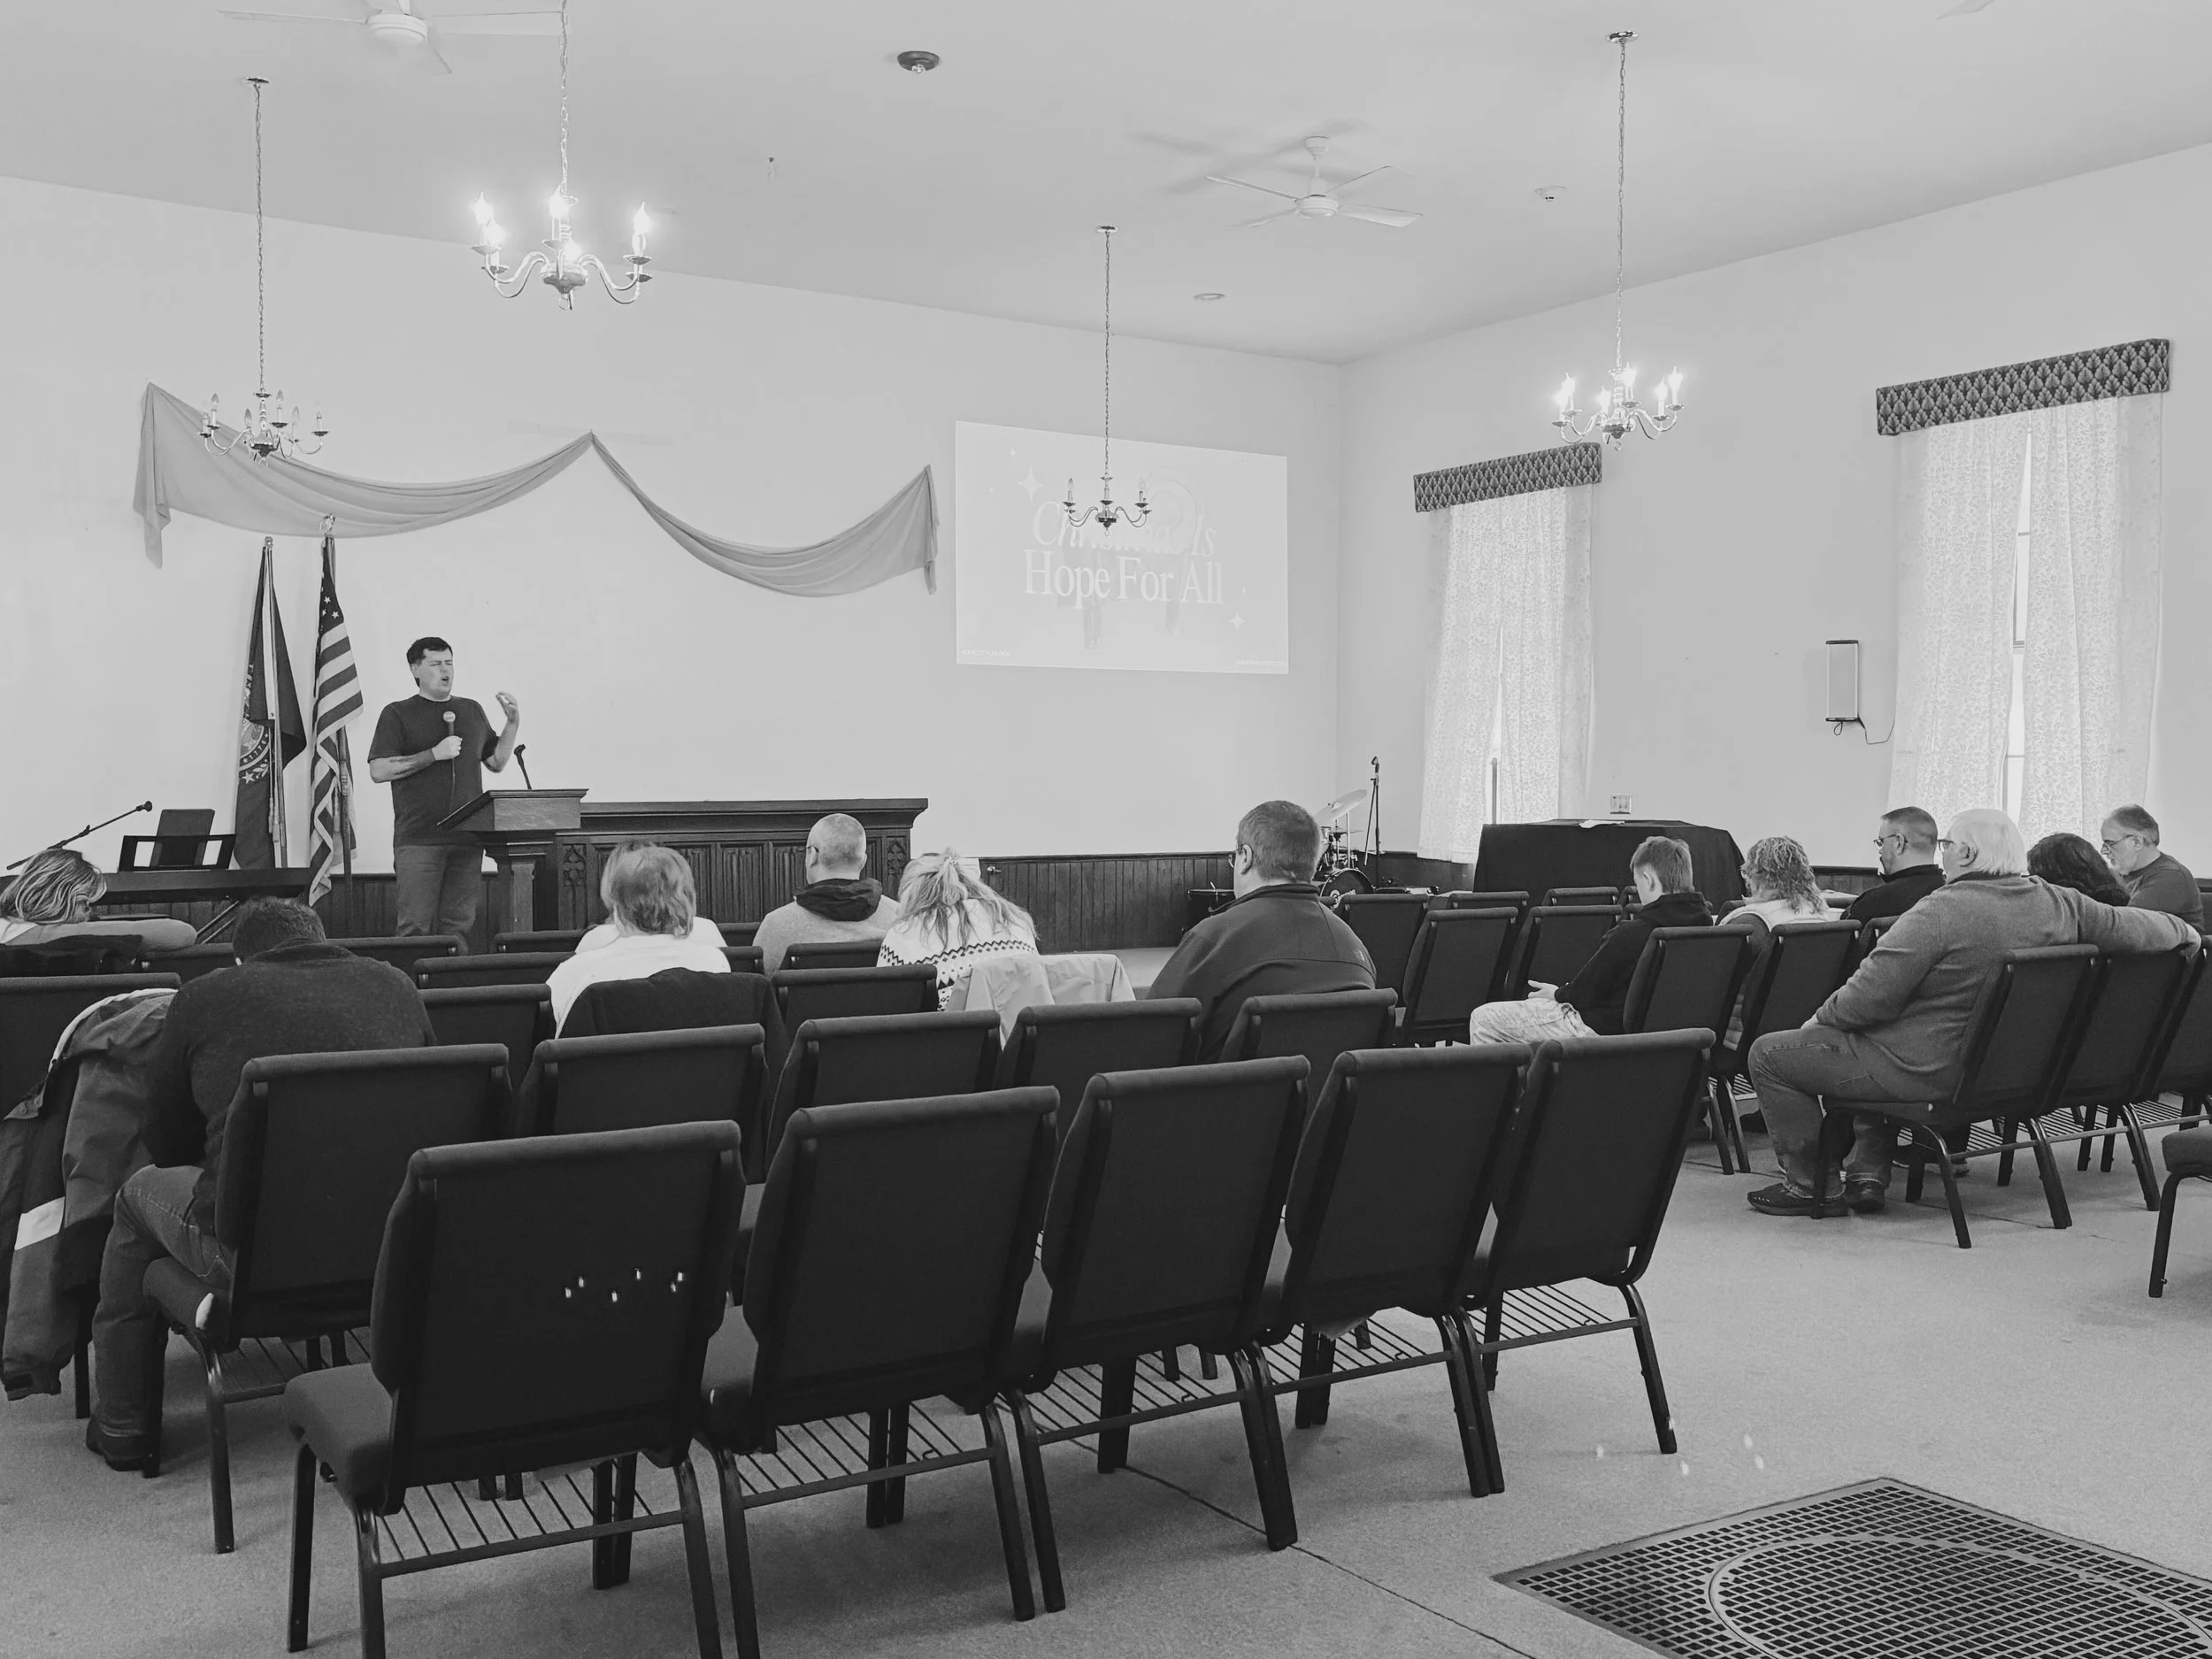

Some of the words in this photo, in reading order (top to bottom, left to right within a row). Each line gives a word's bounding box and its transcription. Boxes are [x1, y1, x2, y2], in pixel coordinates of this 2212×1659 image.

[1022, 549, 1111, 609] Hope
[1115, 556, 1175, 603] For
[1179, 560, 1225, 604] All
